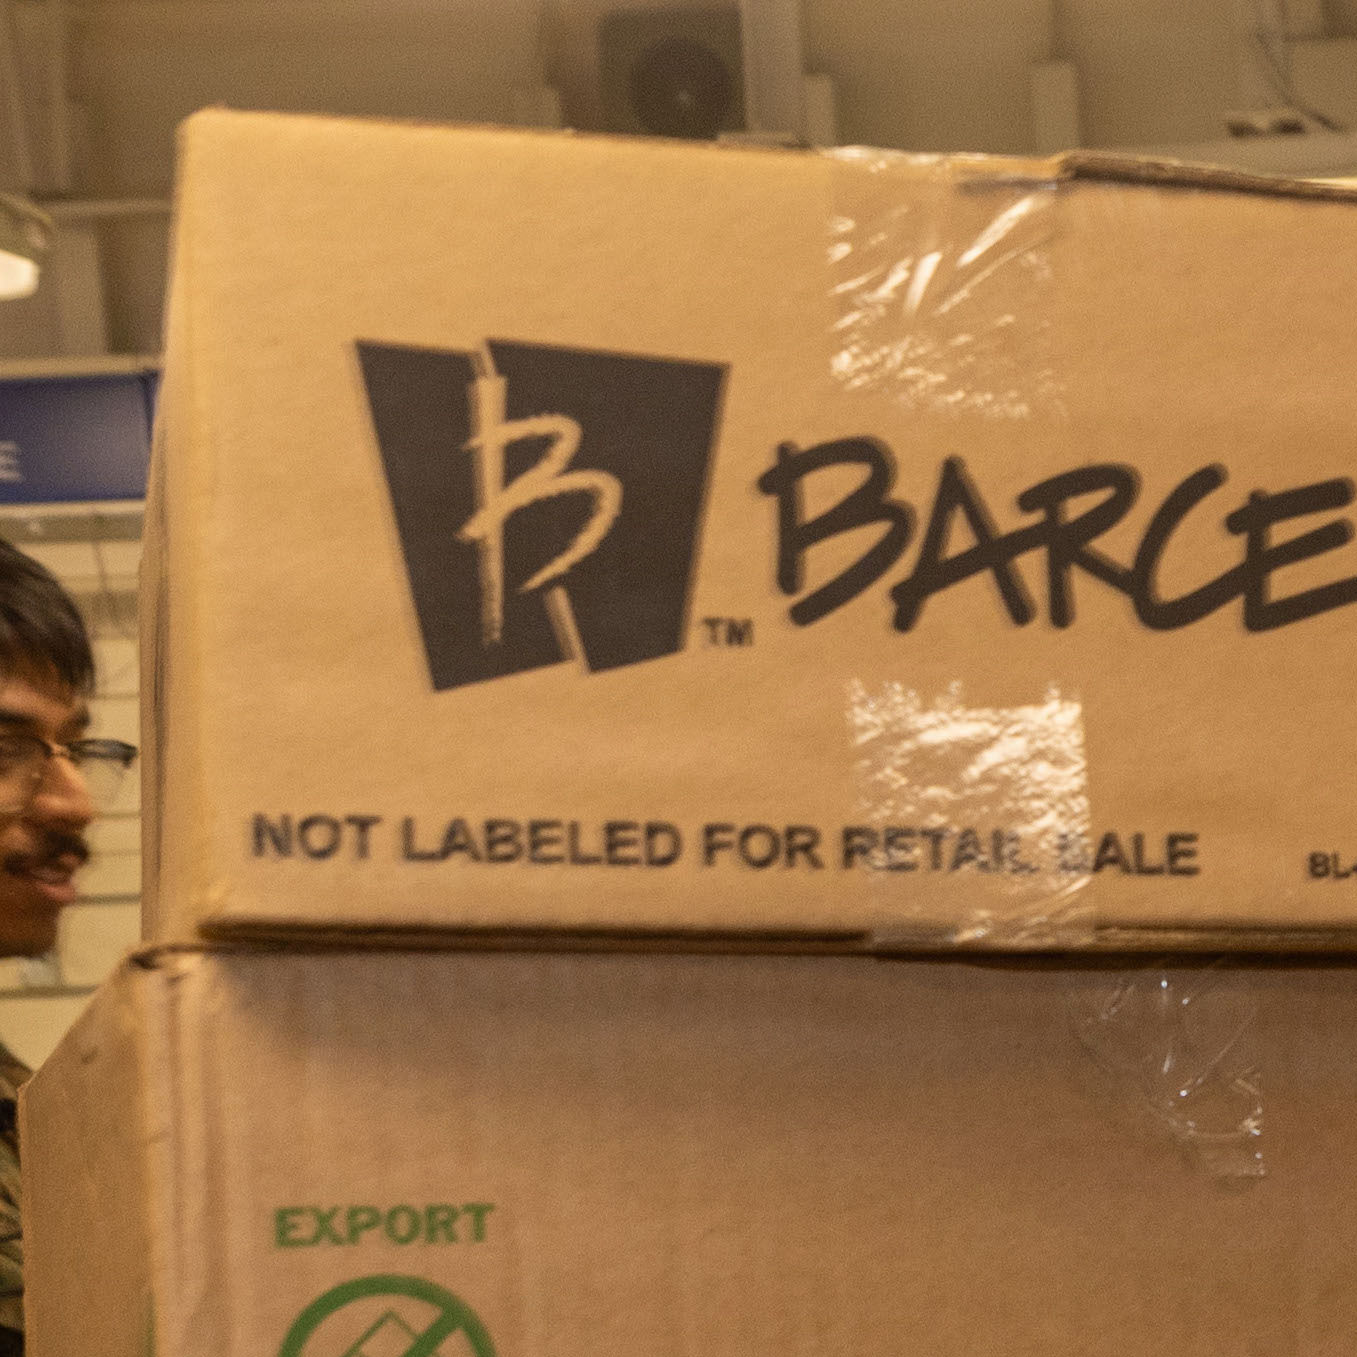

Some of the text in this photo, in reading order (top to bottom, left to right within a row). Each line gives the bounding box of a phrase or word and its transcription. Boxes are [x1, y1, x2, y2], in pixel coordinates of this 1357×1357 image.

[250, 812, 383, 862] NOT
[402, 816, 683, 868] LABELED
[702, 822, 824, 870] FOR
[271, 1204, 496, 1250] EXPORT
